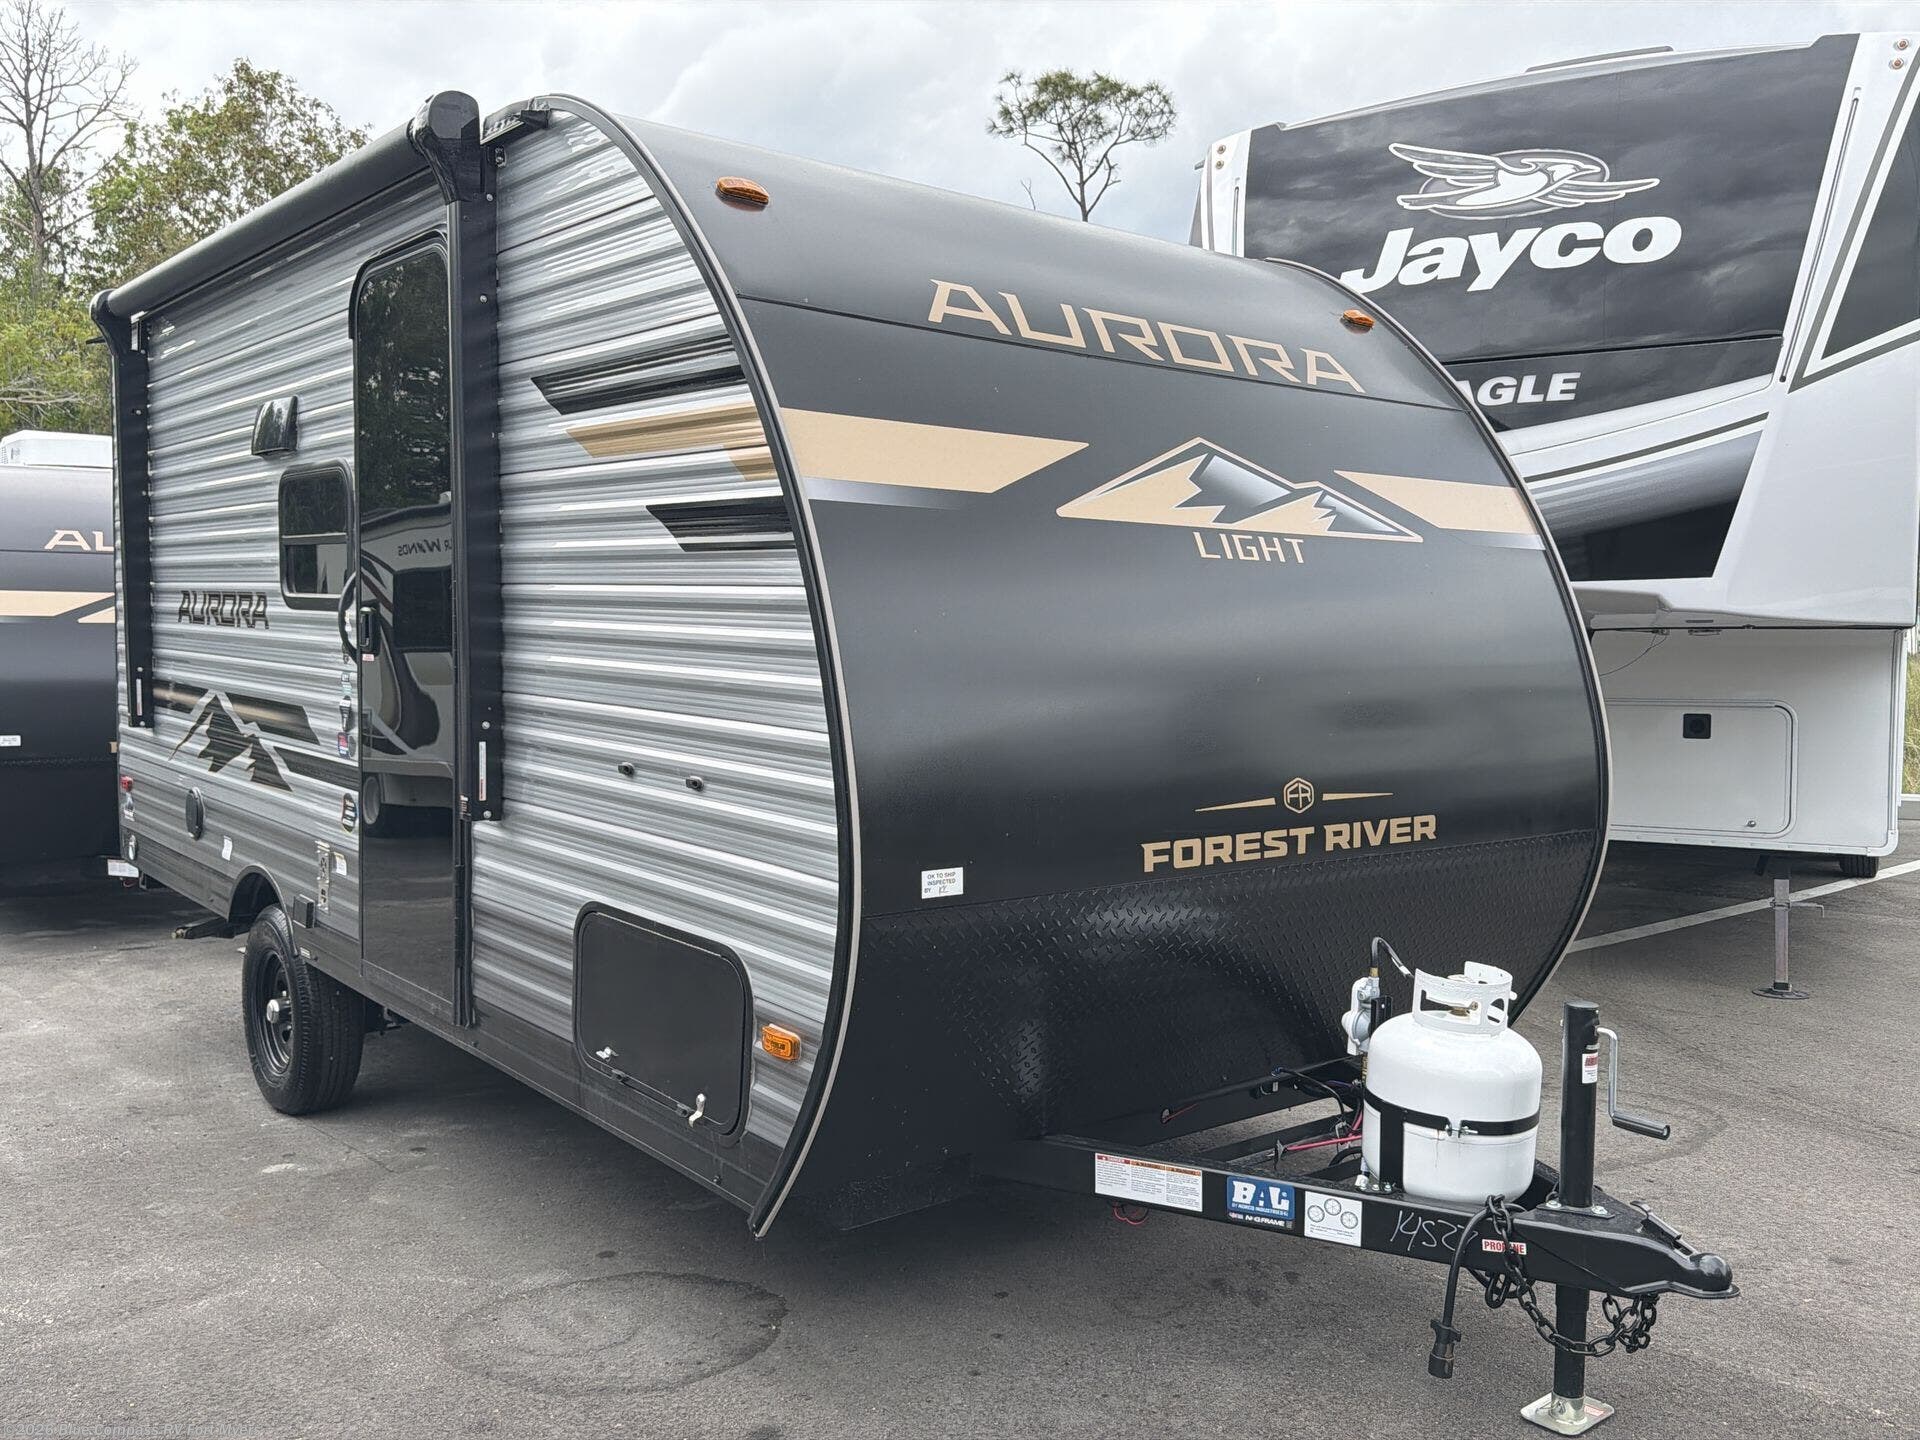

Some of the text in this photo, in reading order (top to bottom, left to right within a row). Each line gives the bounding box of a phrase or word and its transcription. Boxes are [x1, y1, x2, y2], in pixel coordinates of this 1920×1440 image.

[1340, 216, 1682, 294] Jayco
[927, 279, 1365, 393] AURORA
[1193, 531, 1304, 563] LIGHT
[178, 590, 269, 629] AURORA
[1141, 814, 1437, 873] FOREST RIVER
[927, 878, 956, 886] INSPECTED
[1232, 1180, 1290, 1211] BAL
[1484, 1240, 1525, 1254] PROPNE
